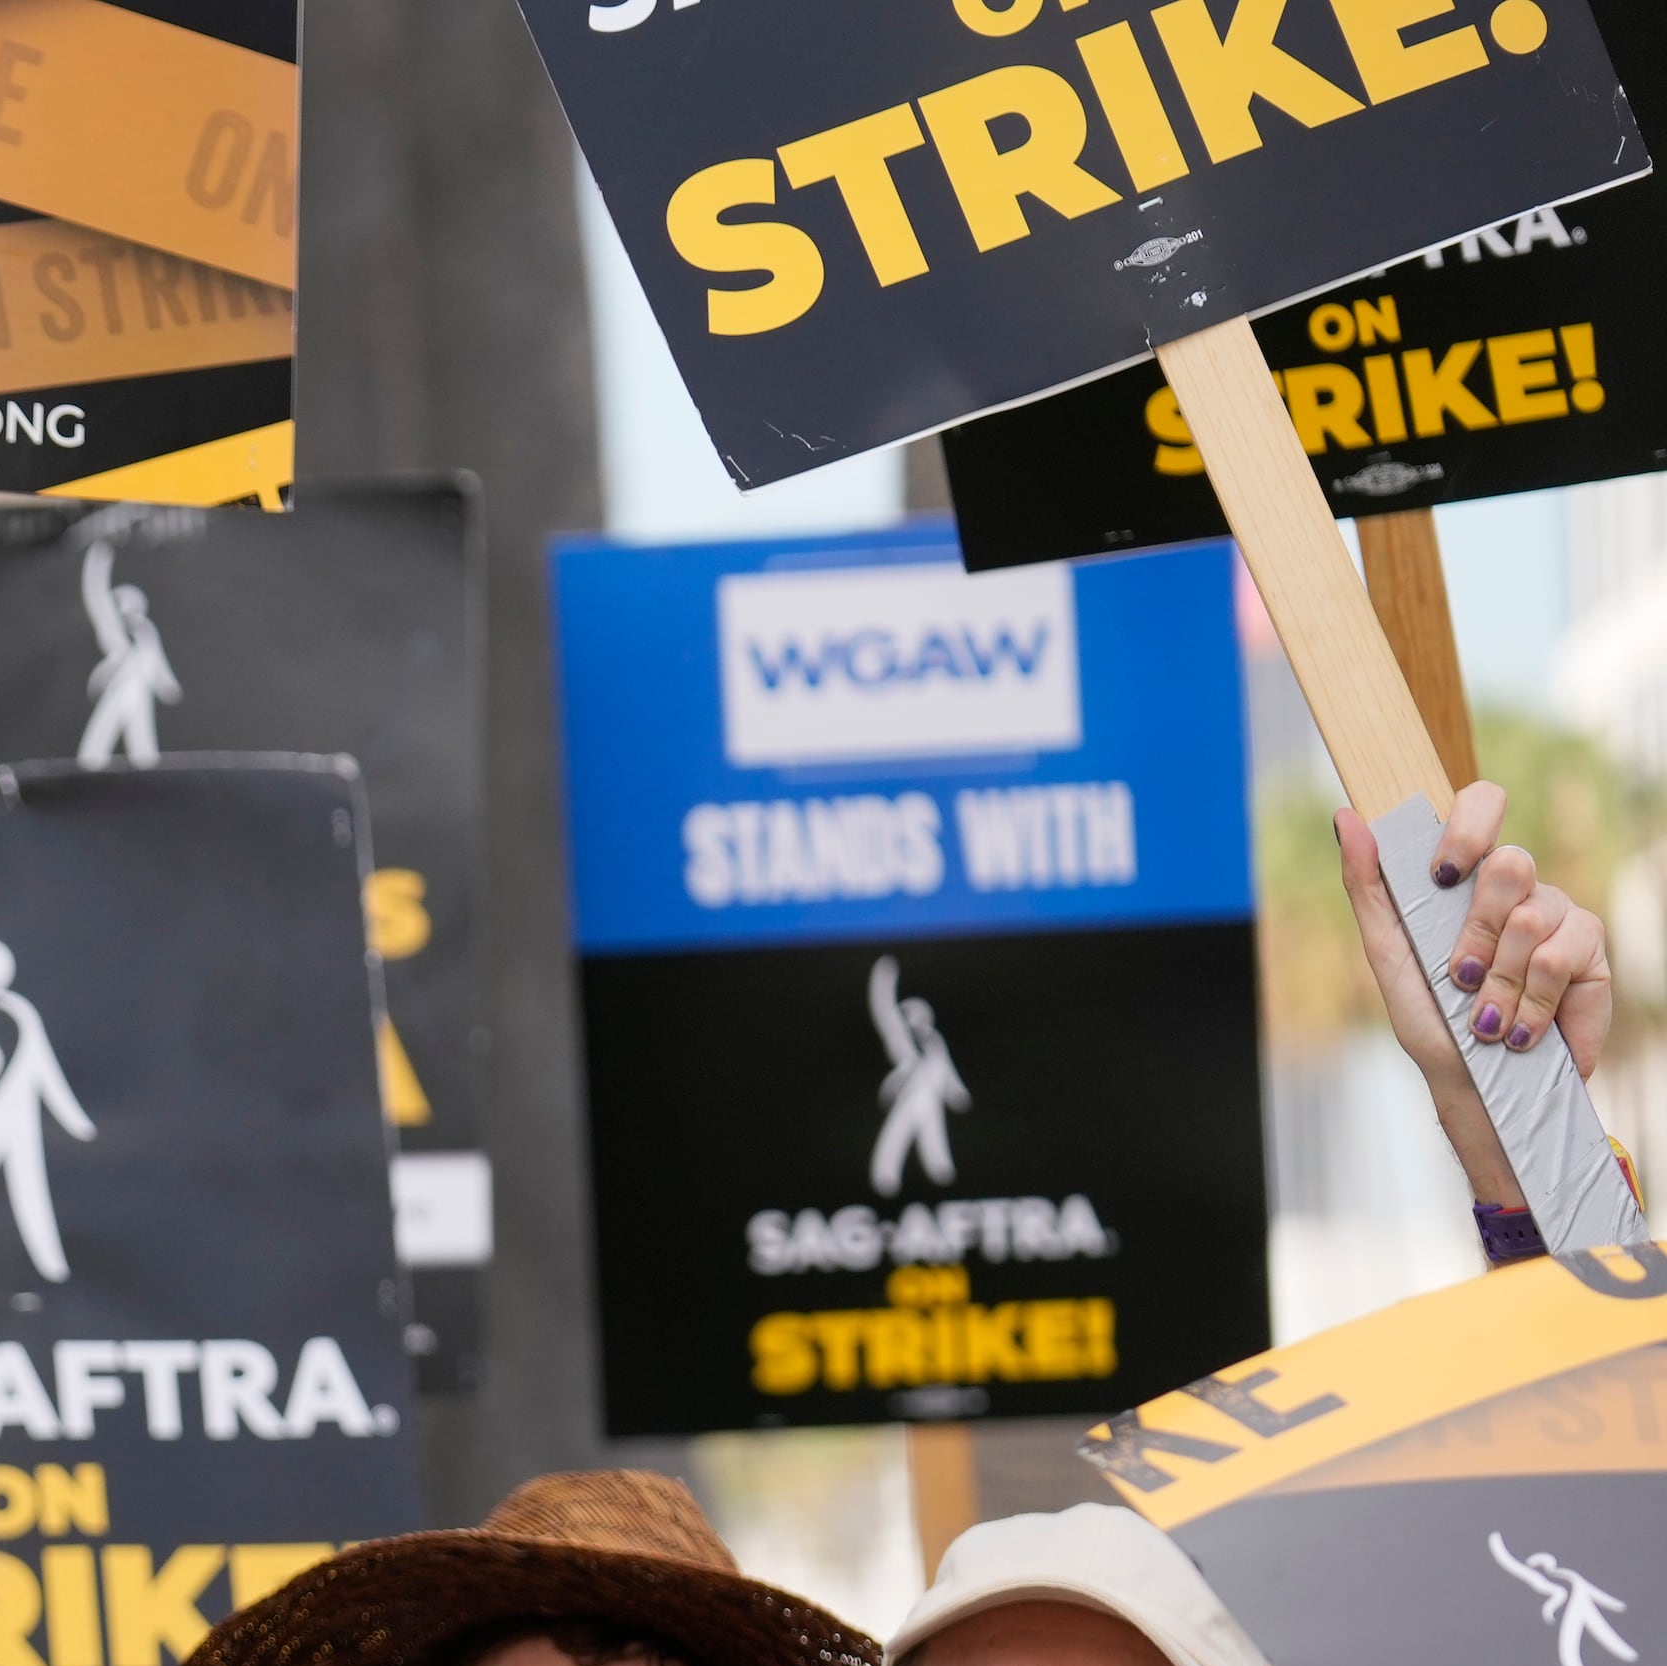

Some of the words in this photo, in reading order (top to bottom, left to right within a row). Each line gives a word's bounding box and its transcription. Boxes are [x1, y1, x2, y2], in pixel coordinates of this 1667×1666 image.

[1308, 294, 1402, 353] ON
[1145, 321, 1607, 476] SRIKE!
[747, 622, 1050, 690] WGAW
[683, 790, 946, 909] STANDS
[956, 780, 1138, 892] WITH
[750, 1296, 1118, 1394] STRIKE!
